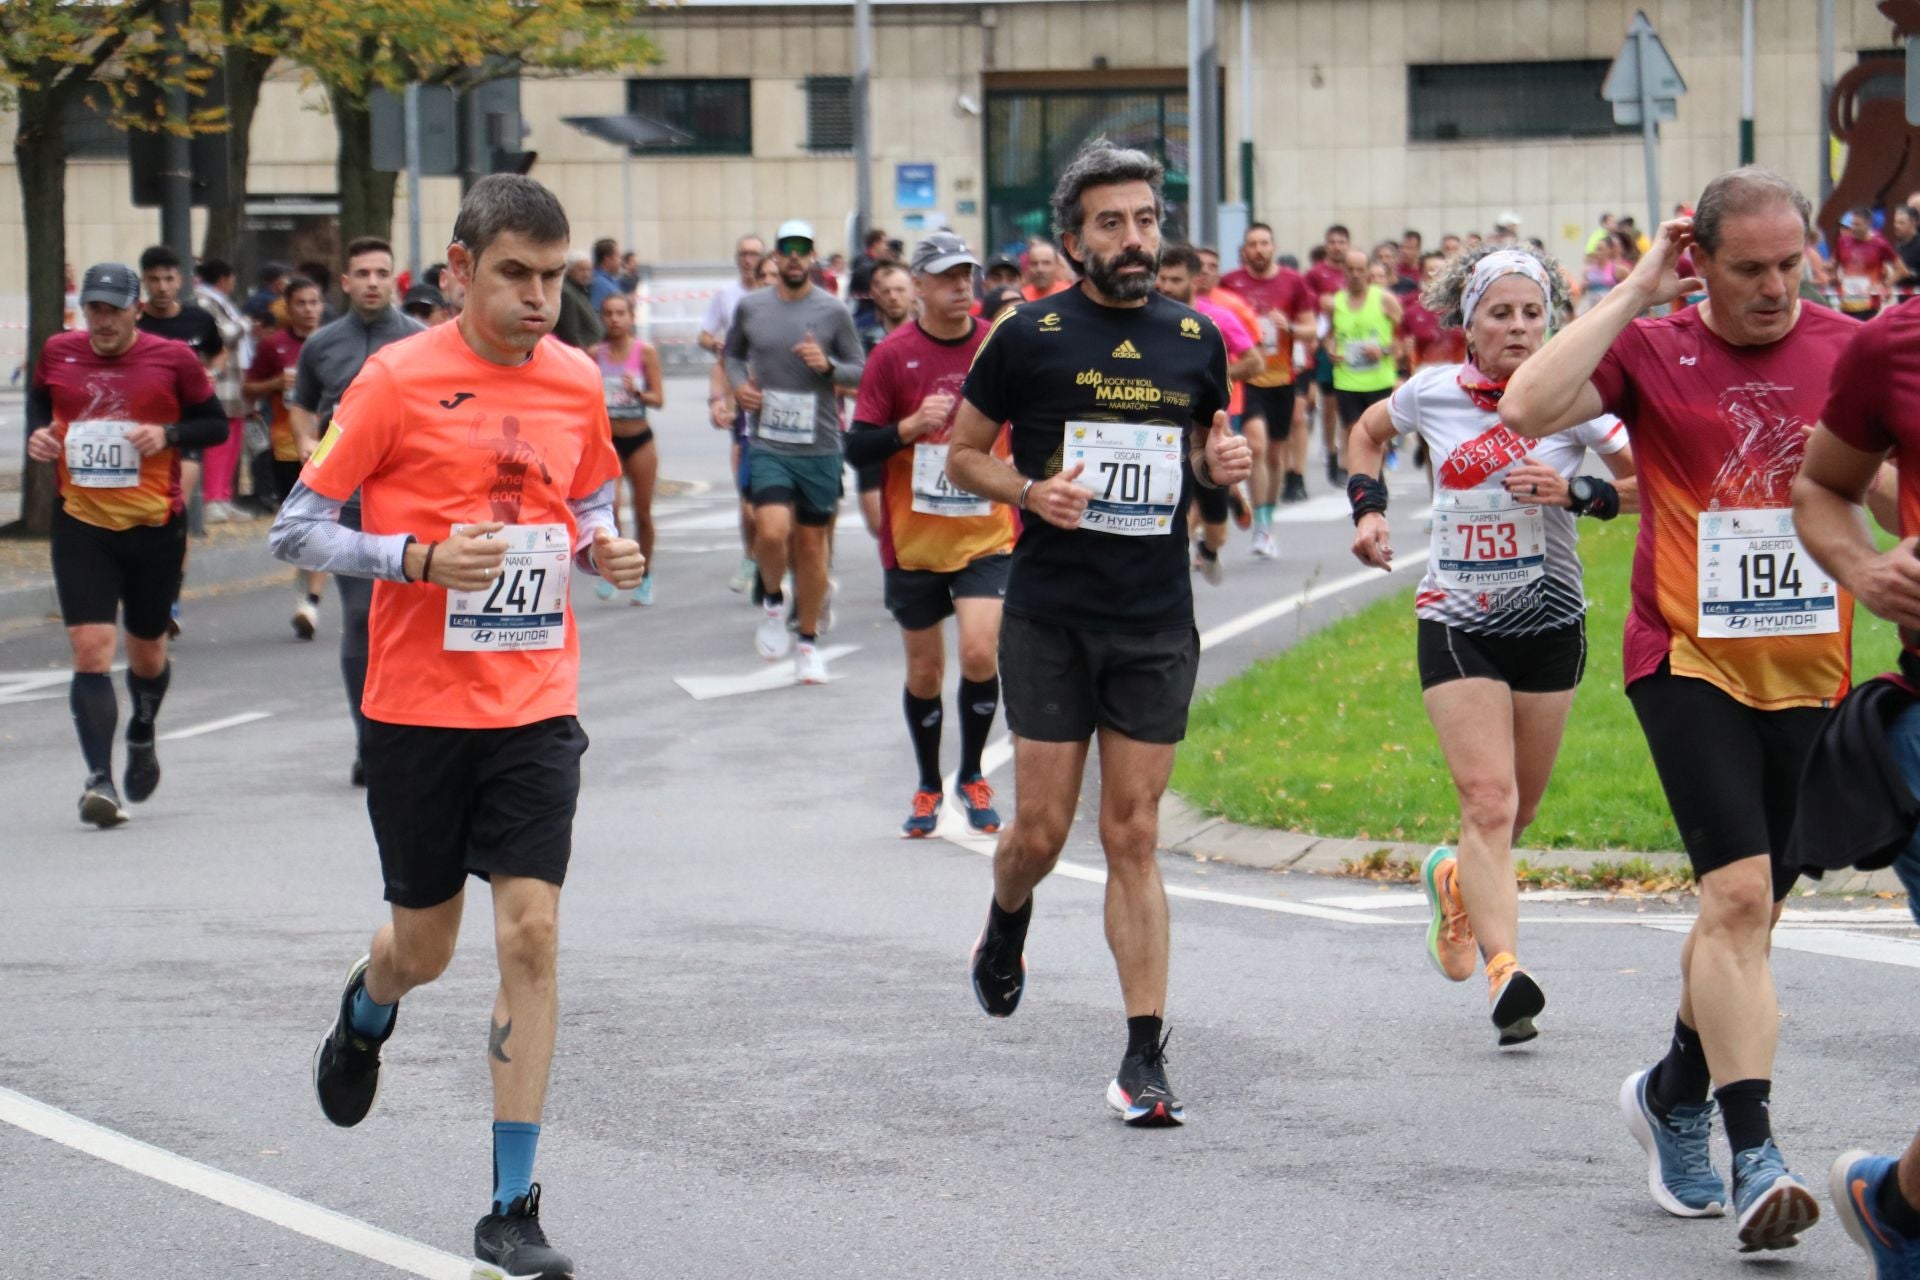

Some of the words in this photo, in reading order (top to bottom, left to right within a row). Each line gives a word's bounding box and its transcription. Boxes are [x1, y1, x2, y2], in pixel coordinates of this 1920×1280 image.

[1112, 350, 1141, 359] adidas
[1075, 367, 1102, 388] edp
[1095, 385, 1161, 402] MADRID
[1108, 402, 1148, 411] MARATÓN
[81, 443, 121, 468] 340
[1113, 451, 1141, 461] OSCAR
[1479, 455, 1501, 475] DE
[1099, 462, 1151, 503] 701
[1107, 515, 1156, 527] HYUNDAI
[1469, 513, 1501, 523] CARMEN
[1457, 522, 1518, 561] 753
[1748, 540, 1793, 551] ALBERTO
[1476, 570, 1529, 581] HYUNDAI
[1738, 552, 1802, 599] 194
[482, 568, 546, 614] 247
[1754, 613, 1817, 627] HYUNDAI
[498, 629, 549, 642] HYUNDAI
